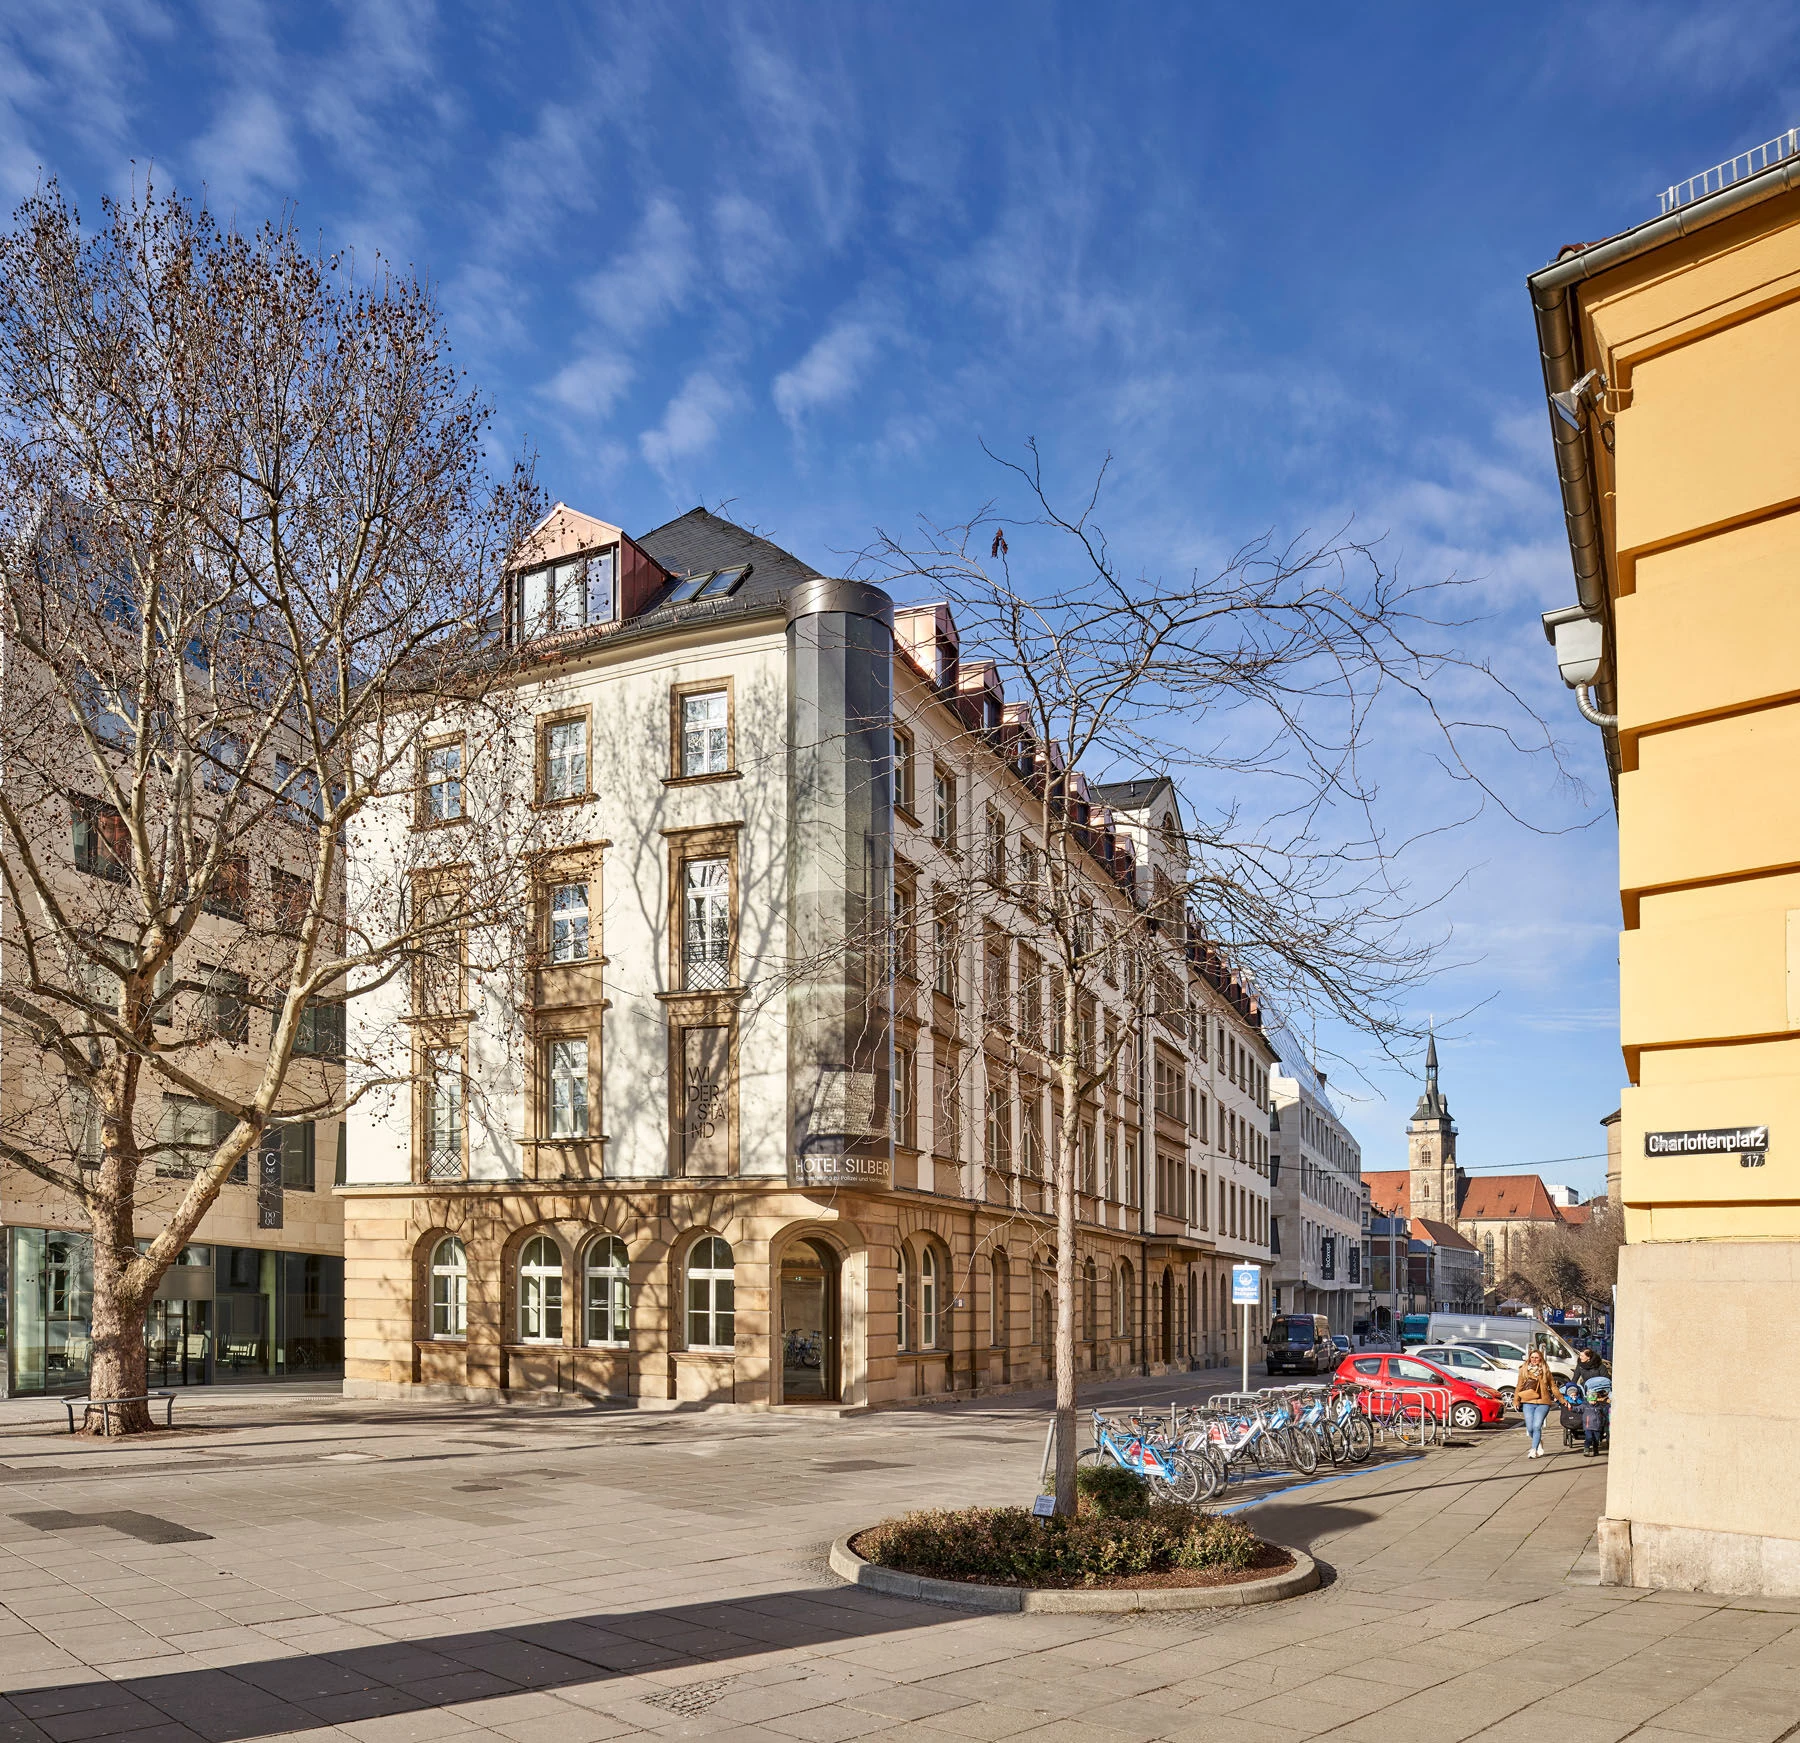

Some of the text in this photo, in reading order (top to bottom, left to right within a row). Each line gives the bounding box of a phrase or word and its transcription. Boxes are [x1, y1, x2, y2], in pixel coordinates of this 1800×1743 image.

[688, 1067, 710, 1083] WI
[688, 1085, 719, 1102] DER
[698, 1103, 726, 1120] STA
[692, 1122, 715, 1138] ND
[1649, 1128, 1765, 1153] Charlottenplatz
[795, 1158, 890, 1176] HOTEL SILBER
[1746, 1155, 1759, 1167] 17
